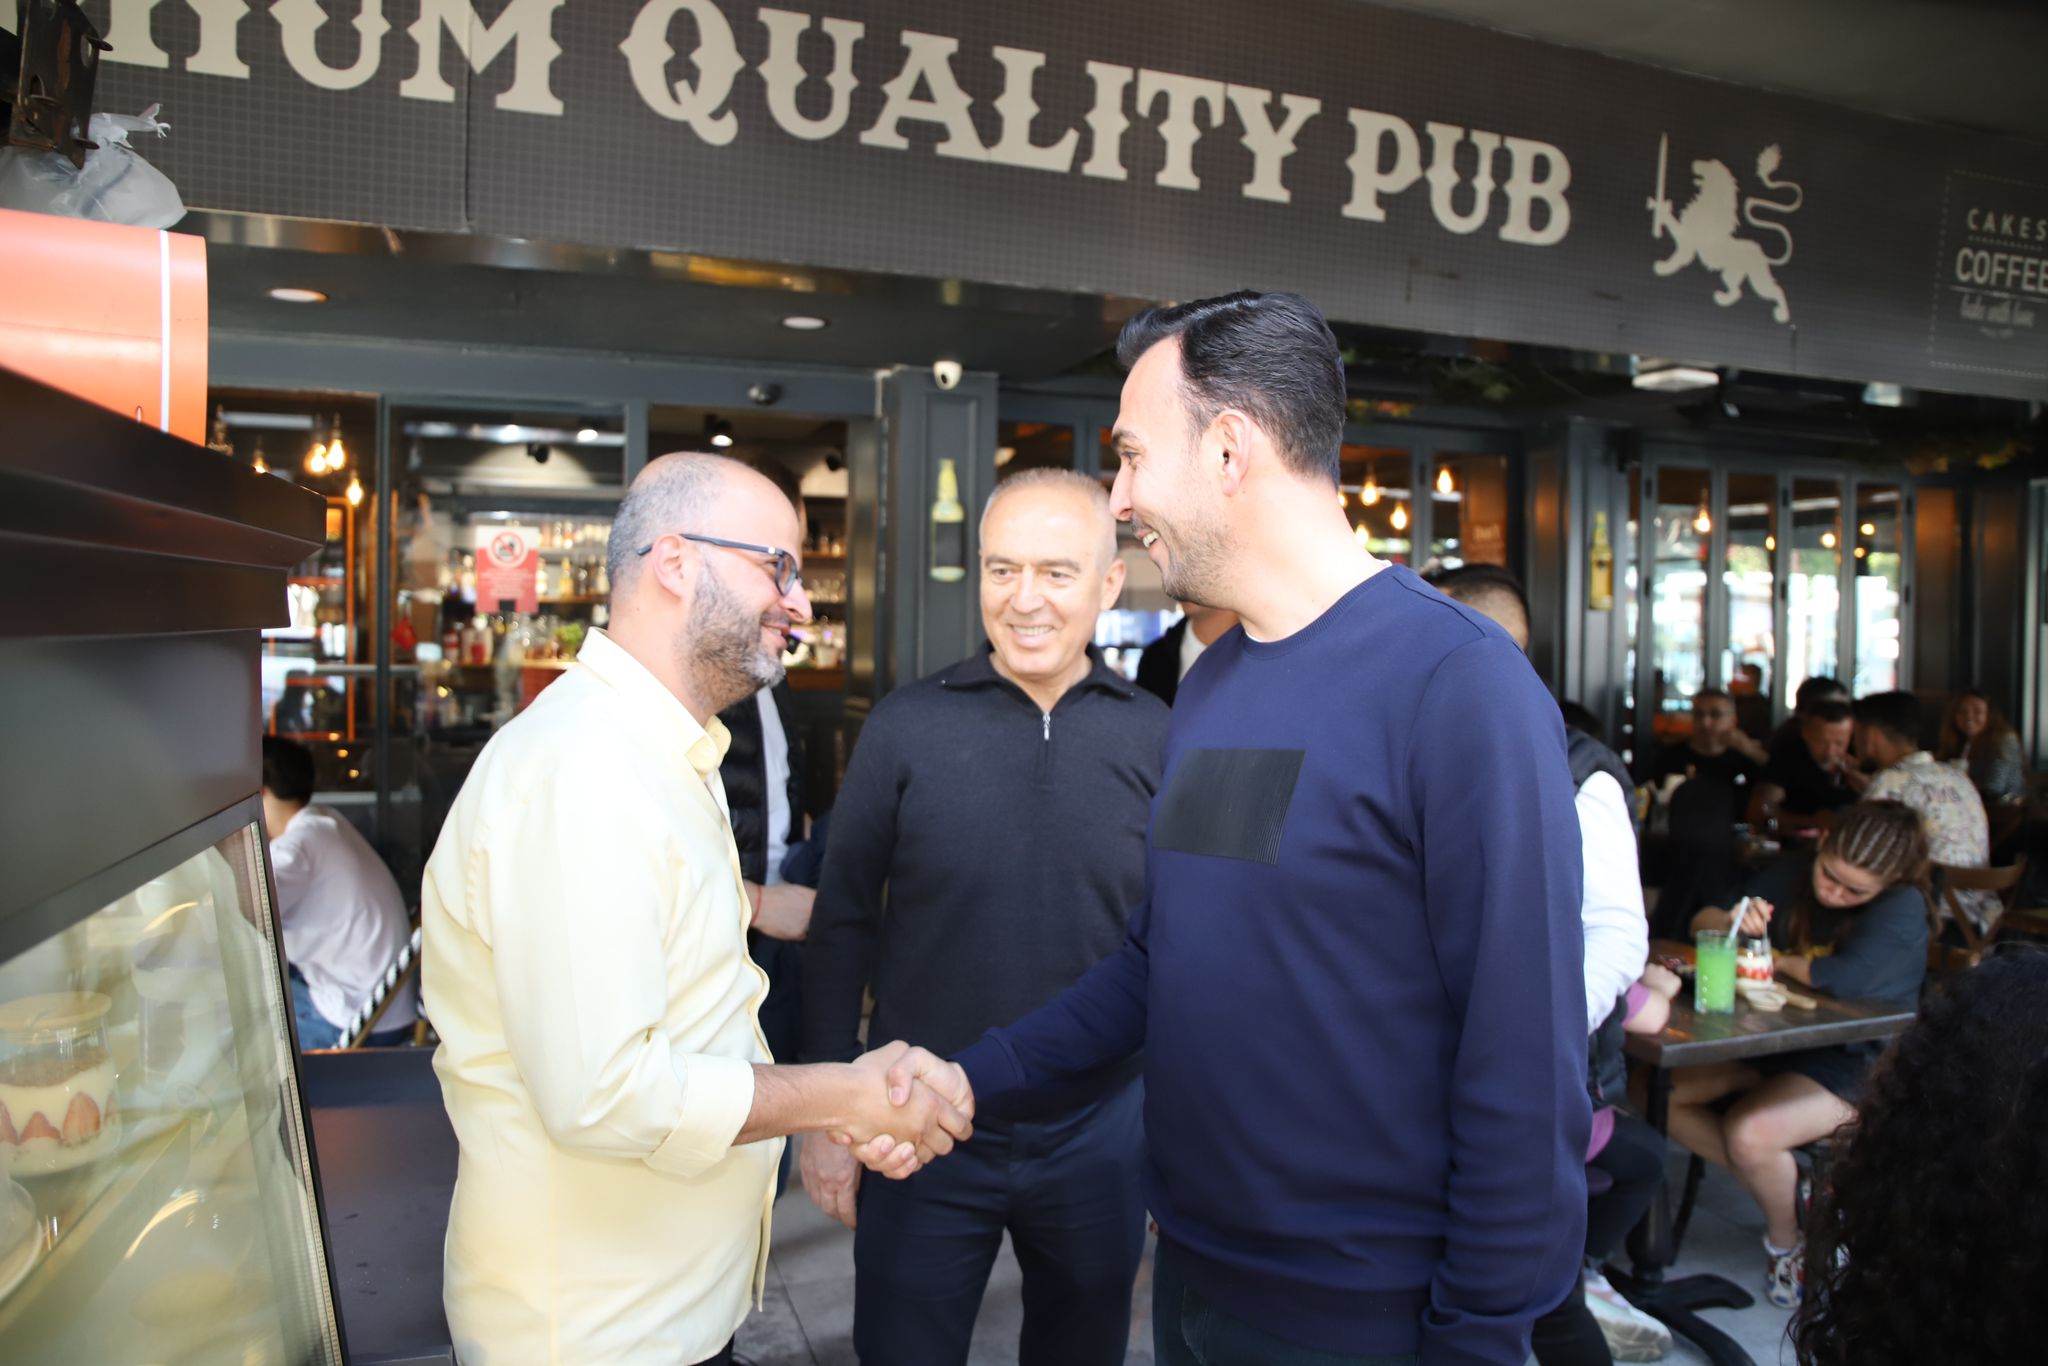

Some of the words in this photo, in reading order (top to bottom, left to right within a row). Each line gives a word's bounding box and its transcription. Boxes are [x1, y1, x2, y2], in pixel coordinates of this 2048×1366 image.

[619, 0, 1321, 203] QUALITY
[1341, 107, 1572, 247] PUB
[1966, 207, 2048, 242] CAKES
[1955, 246, 2048, 294] COFFEE
